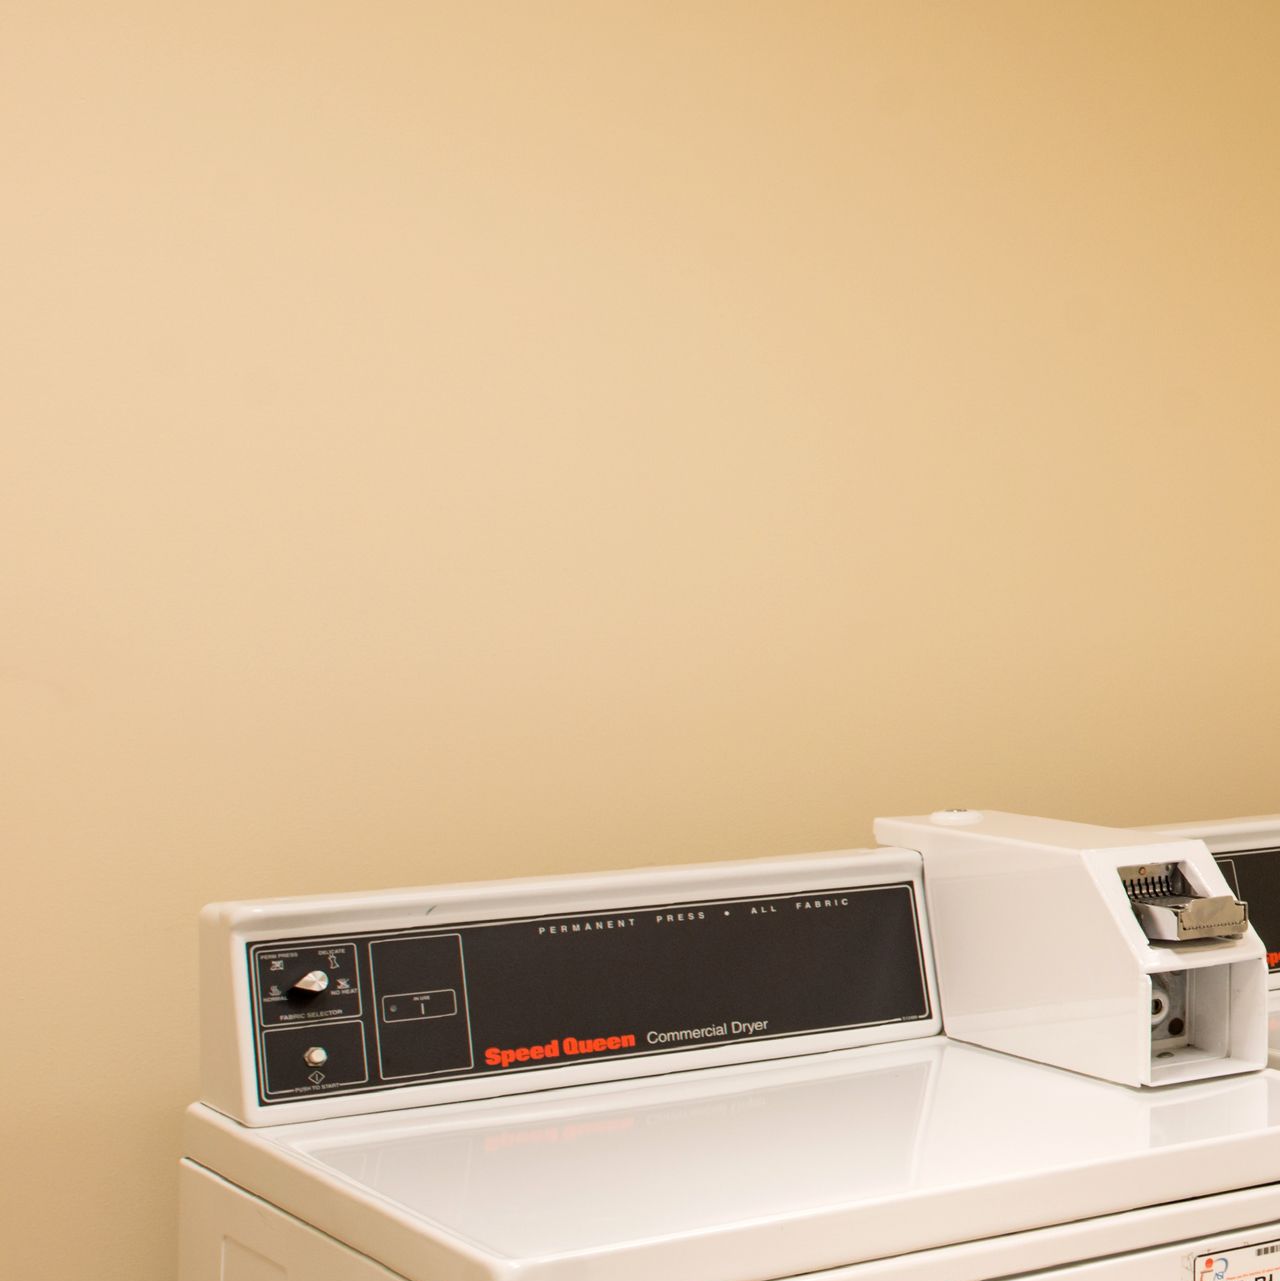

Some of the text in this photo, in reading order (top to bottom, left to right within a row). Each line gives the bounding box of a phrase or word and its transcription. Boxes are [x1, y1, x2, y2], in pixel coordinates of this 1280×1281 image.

[538, 898, 849, 935] PERMANENT PRESS ALL FABRIC
[318, 948, 346, 956] DELICATE
[280, 1008, 343, 1021] FABRIC SELECTOR
[646, 1018, 769, 1046] Commercial Dryer
[485, 1032, 636, 1067] Speed Queen
